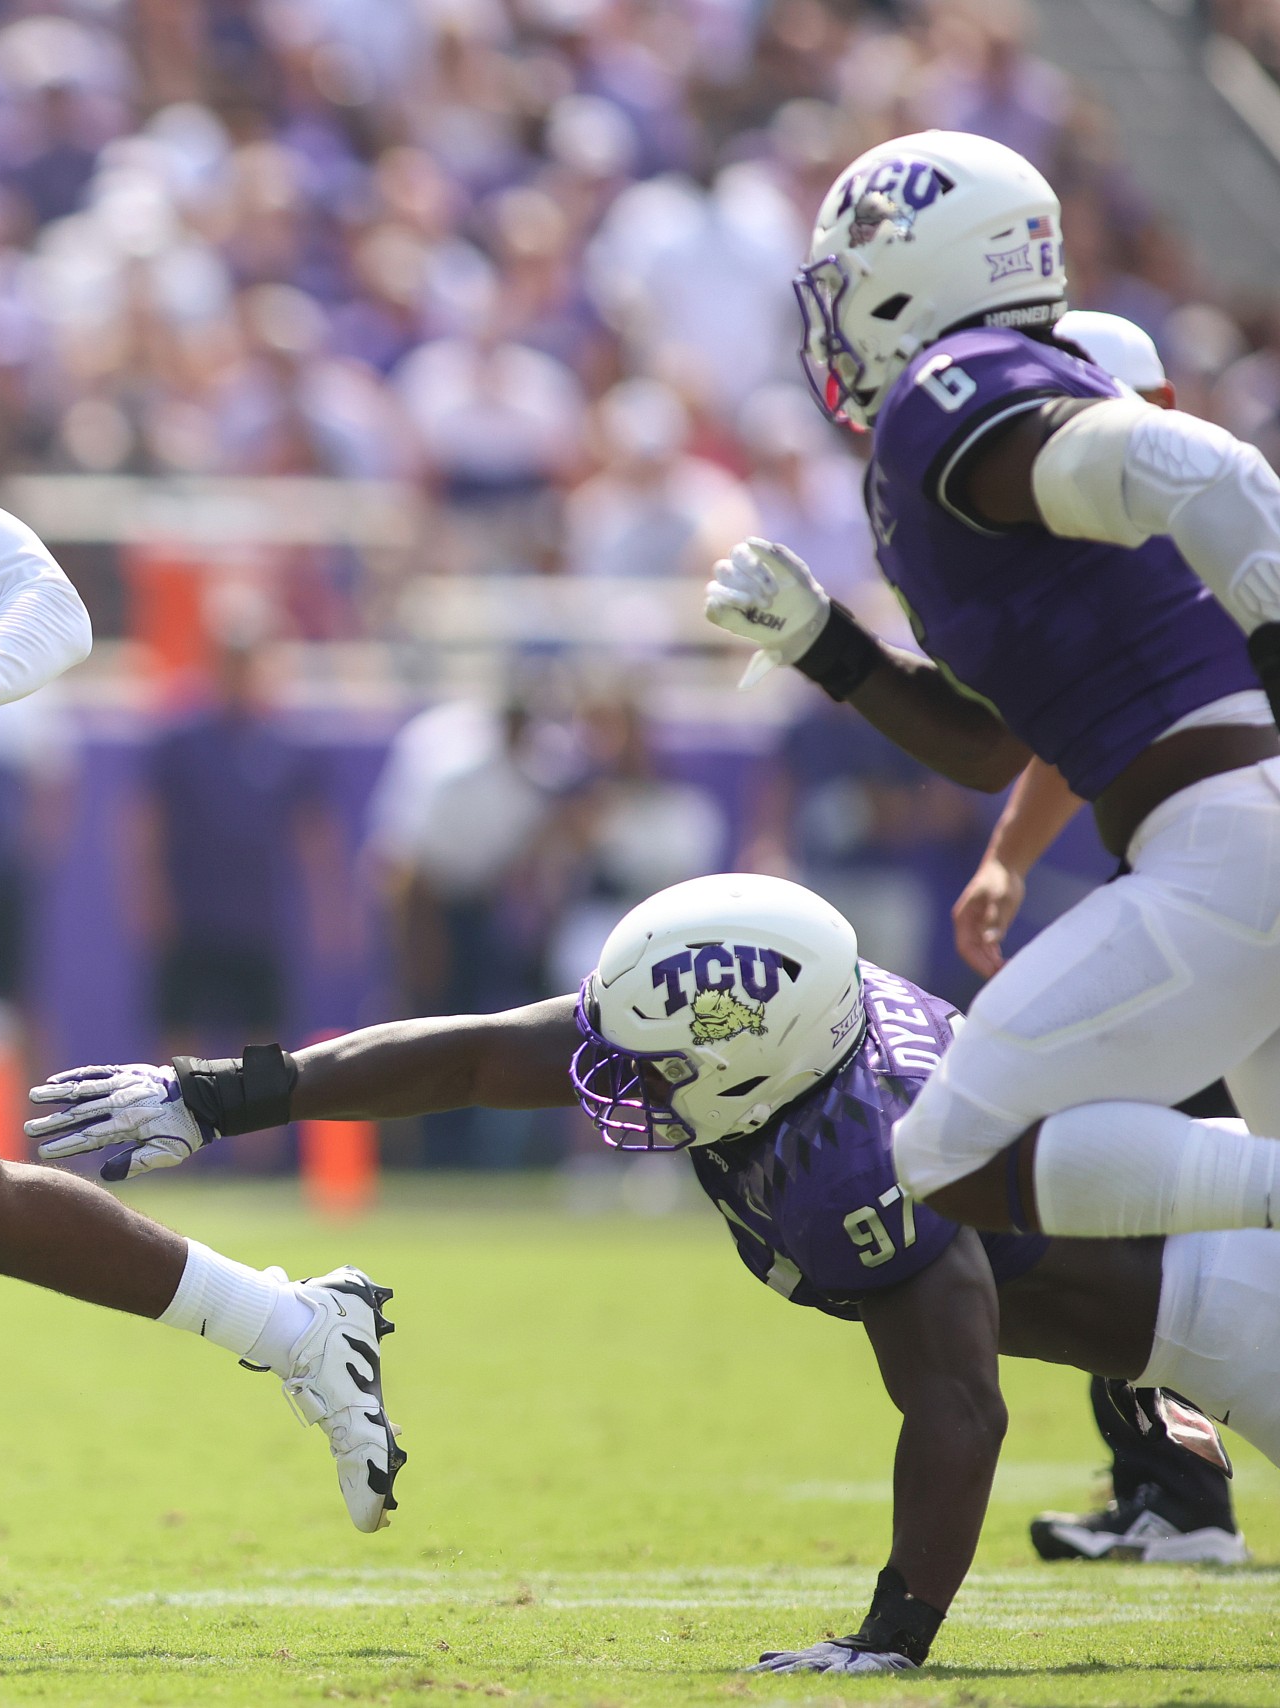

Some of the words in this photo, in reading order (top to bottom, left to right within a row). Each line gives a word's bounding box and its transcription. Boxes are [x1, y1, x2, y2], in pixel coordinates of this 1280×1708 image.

[1040, 241, 1054, 278] 6
[914, 353, 978, 414] 6
[650, 943, 786, 1018] TCU
[706, 1148, 729, 1173] TCU
[843, 1183, 918, 1268] 97
